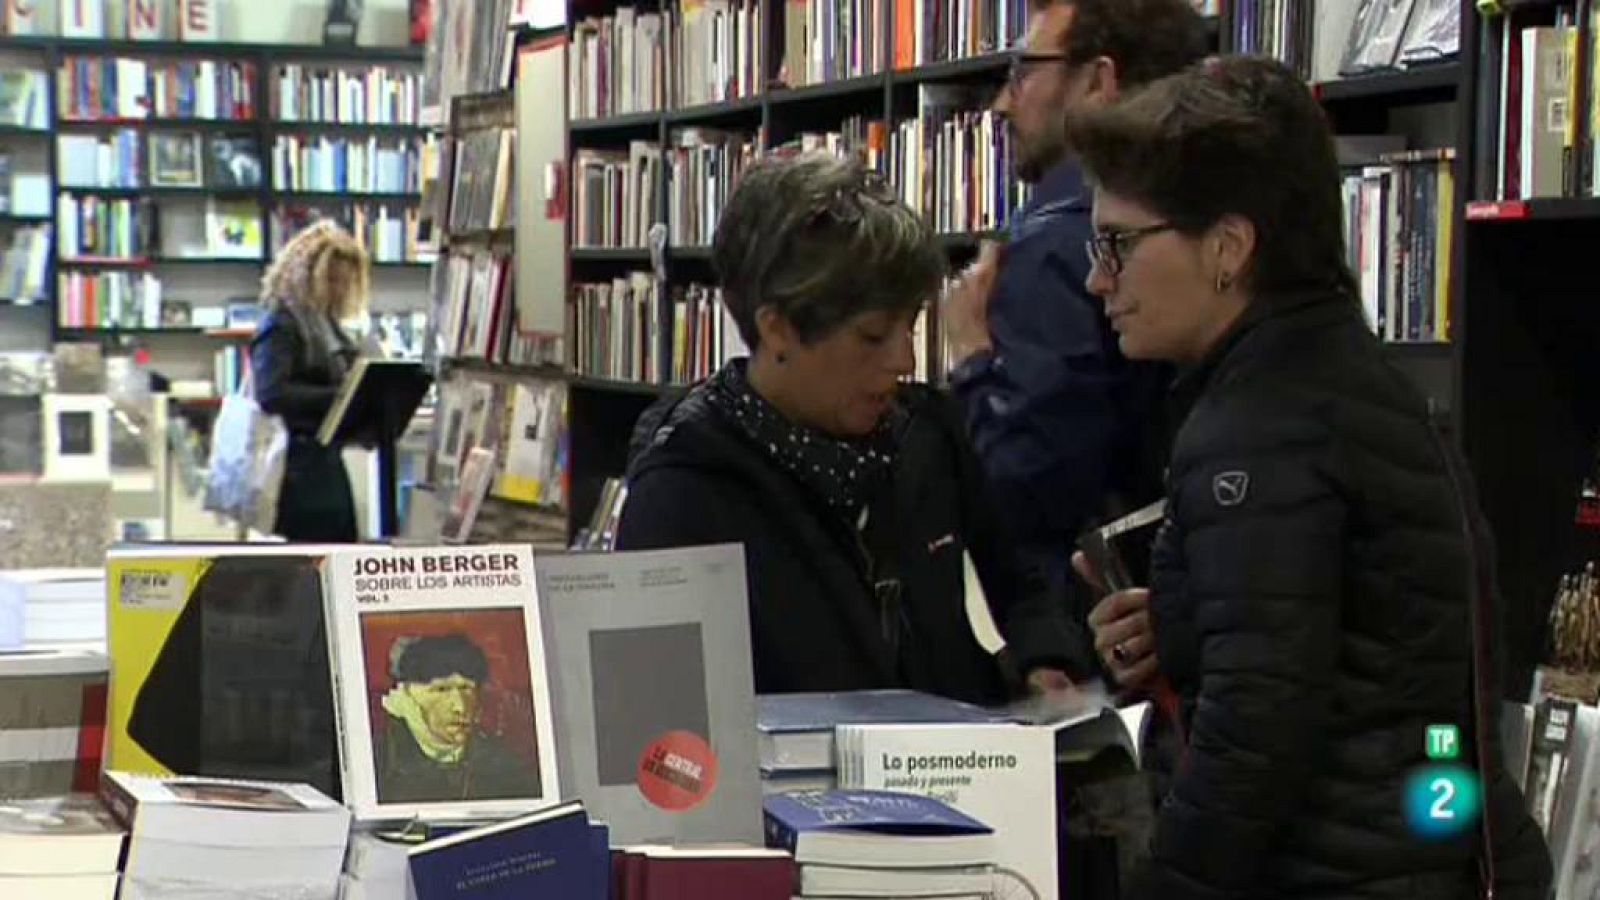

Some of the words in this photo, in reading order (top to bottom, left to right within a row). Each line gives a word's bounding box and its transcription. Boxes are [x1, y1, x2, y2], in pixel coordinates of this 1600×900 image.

[353, 556, 415, 576] JOHN
[421, 553, 519, 573] BERGER
[355, 577, 412, 592] SOBRE
[416, 575, 448, 589] LOS
[452, 574, 522, 588] ARTISTAS
[883, 753, 902, 770] Lo
[908, 750, 1017, 774] posmoderno
